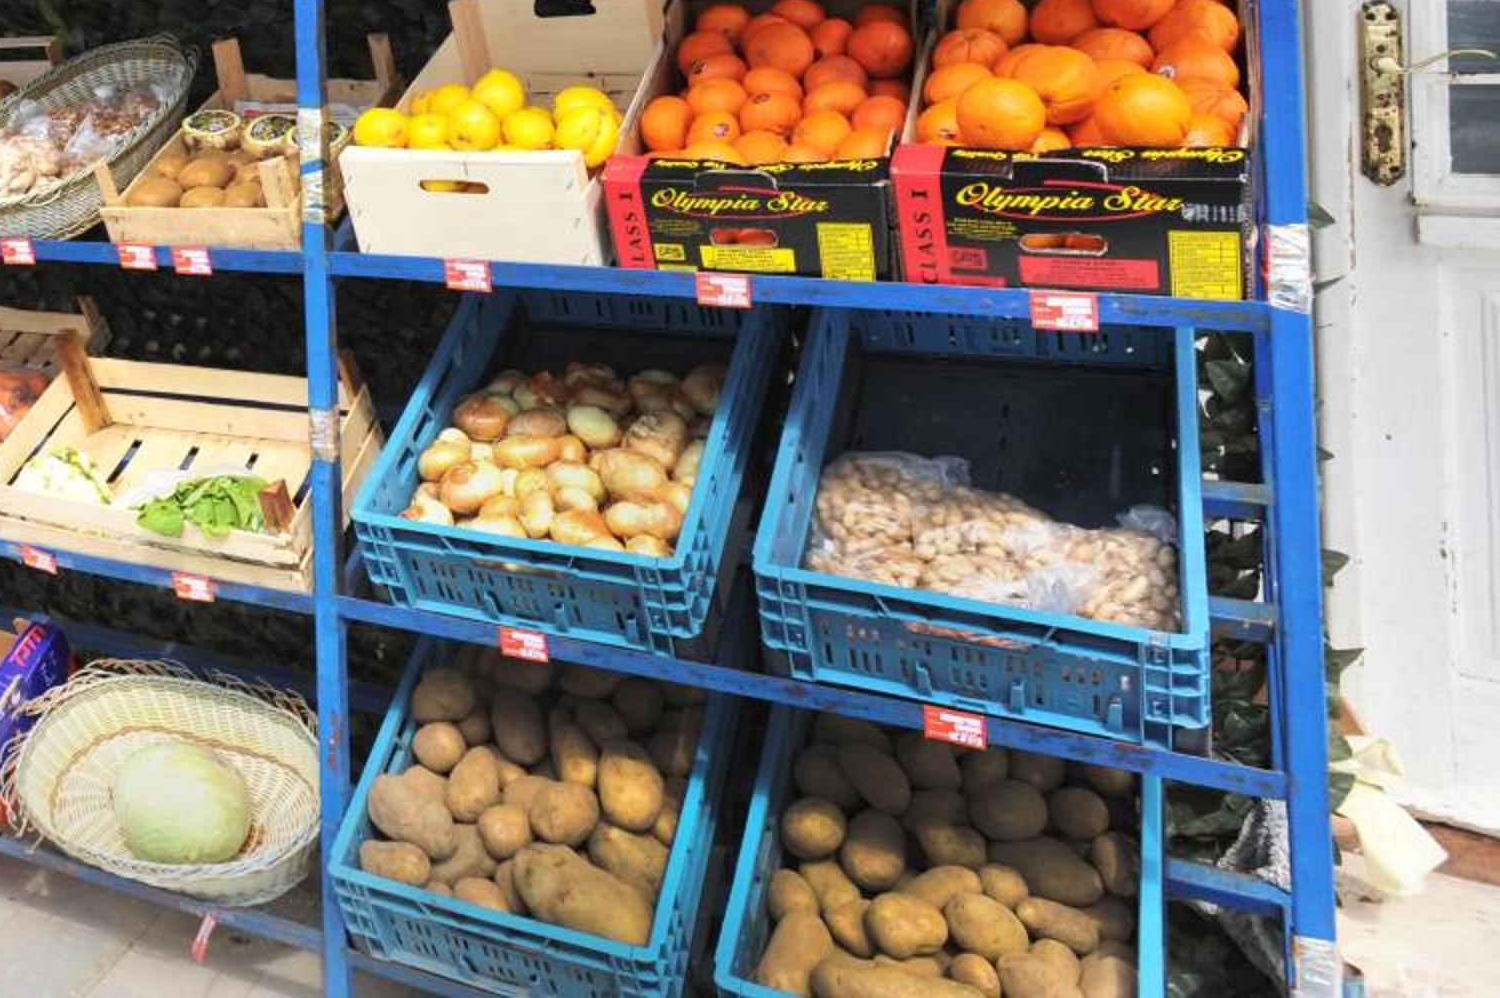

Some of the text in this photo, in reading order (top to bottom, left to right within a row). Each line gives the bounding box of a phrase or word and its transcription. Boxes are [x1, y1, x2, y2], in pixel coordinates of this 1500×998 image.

[651, 187, 831, 216] Olympia Star
[955, 182, 1184, 215] Olympia Star
